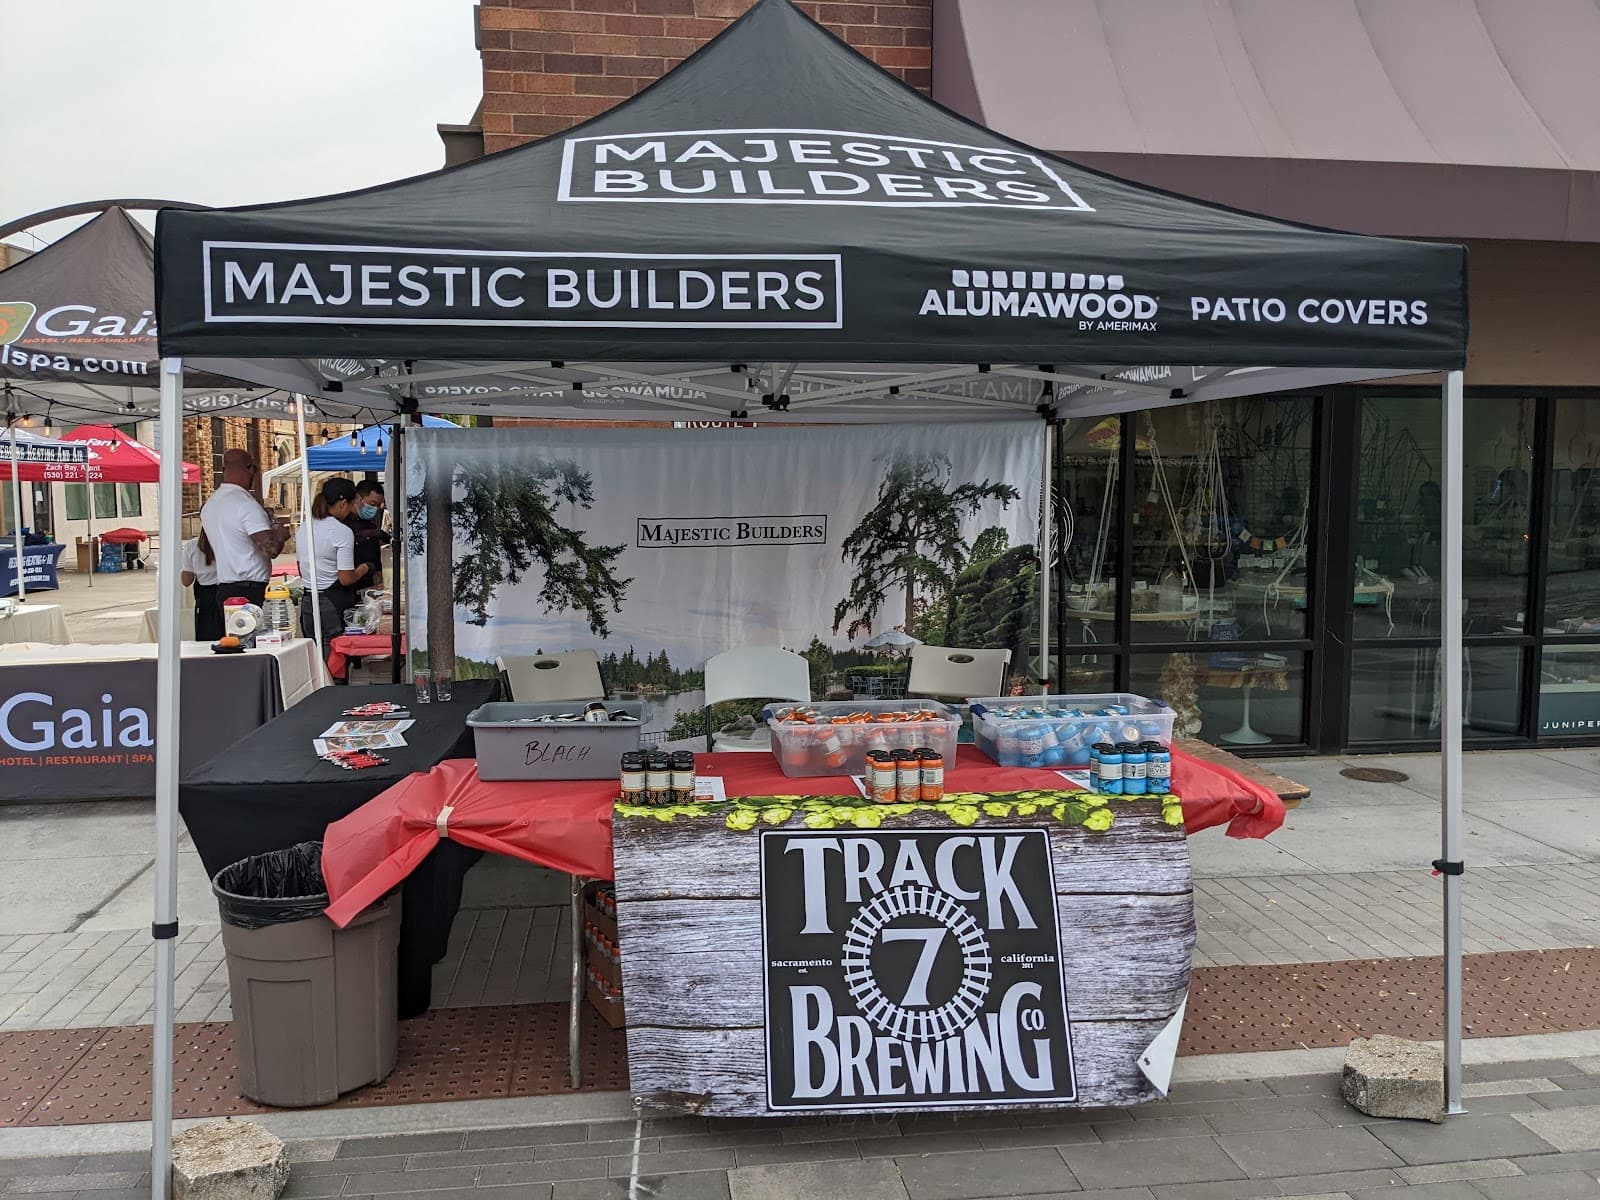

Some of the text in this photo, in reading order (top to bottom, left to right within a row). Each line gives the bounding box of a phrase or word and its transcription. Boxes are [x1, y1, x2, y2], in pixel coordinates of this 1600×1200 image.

[594, 139, 1021, 174] MAJESTIC
[593, 170, 1051, 205] BUILDERS
[224, 261, 825, 311] MAJESTIC BUILDERS
[919, 289, 1158, 320] ALUMAWOOD
[1191, 296, 1428, 325] PATIO COVERS
[1078, 320, 1157, 332] BY AMERIMAX
[27, 443, 55, 462] HEATING
[57, 445, 70, 462] AND
[43, 471, 63, 480] (530)
[64, 471, 79, 479] 221
[640, 521, 824, 545] MAJESTIC BUILDERS
[0, 691, 154, 752] Gaia
[45, 754, 123, 765] RESTAURANT
[131, 754, 154, 764] SPA
[783, 835, 1039, 935] TRACK
[771, 958, 833, 967] sacramento
[880, 926, 950, 1007] 7
[1000, 953, 1055, 963] california
[788, 980, 1055, 1099] BREWING
